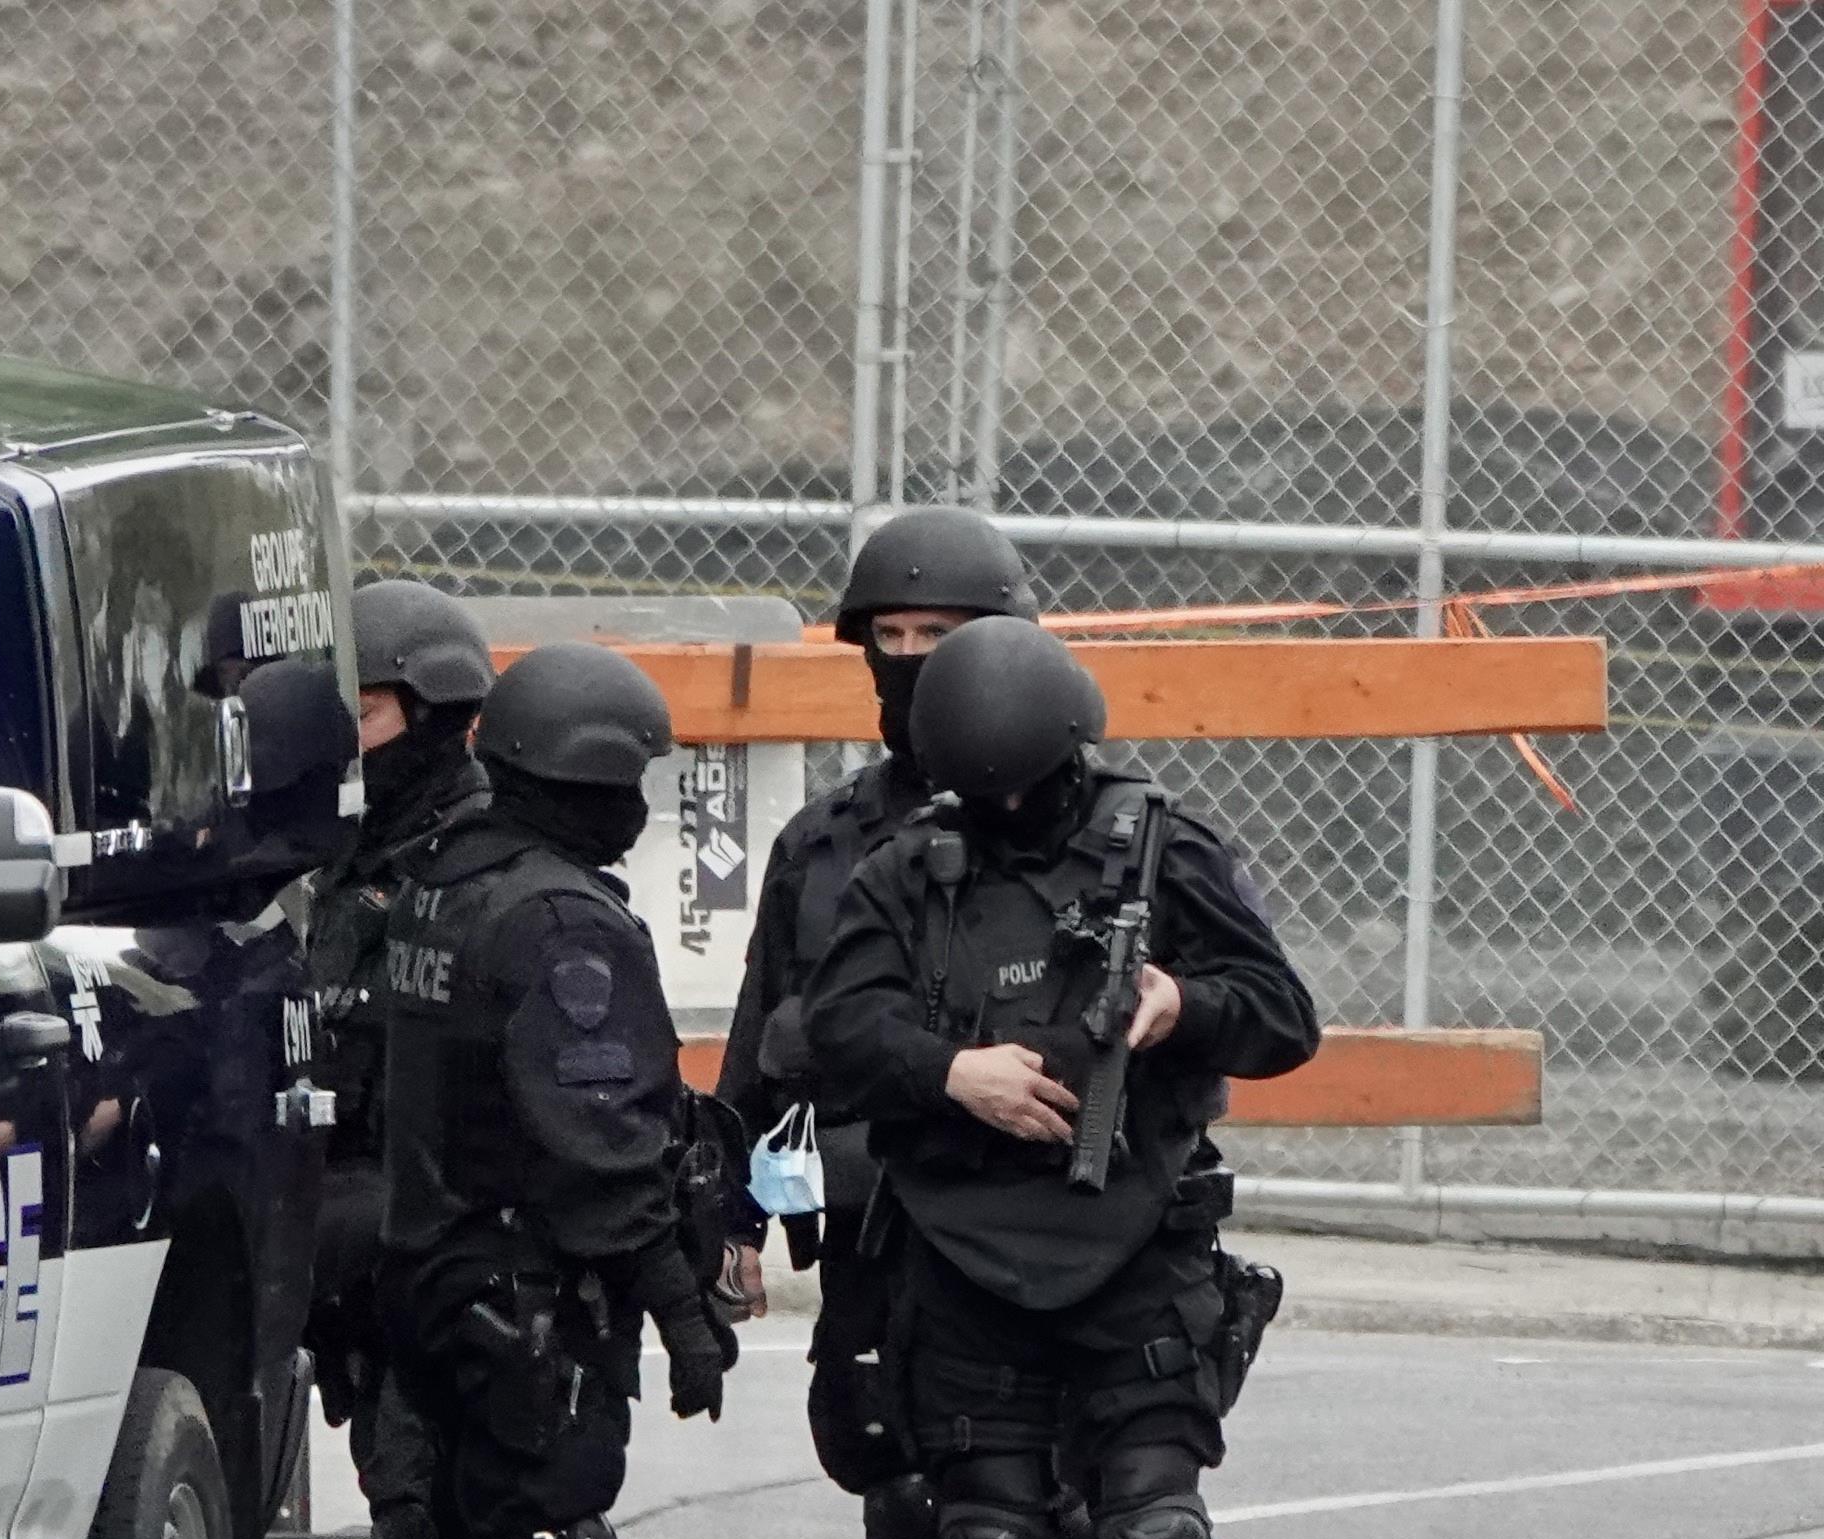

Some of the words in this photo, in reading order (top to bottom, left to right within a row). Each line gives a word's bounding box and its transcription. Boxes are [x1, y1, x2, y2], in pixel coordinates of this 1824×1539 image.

[250, 528, 309, 593] GROUPE
[239, 590, 334, 660] INTERVENTION
[386, 939, 454, 1004] OLICE
[998, 960, 1046, 987] POLIC
